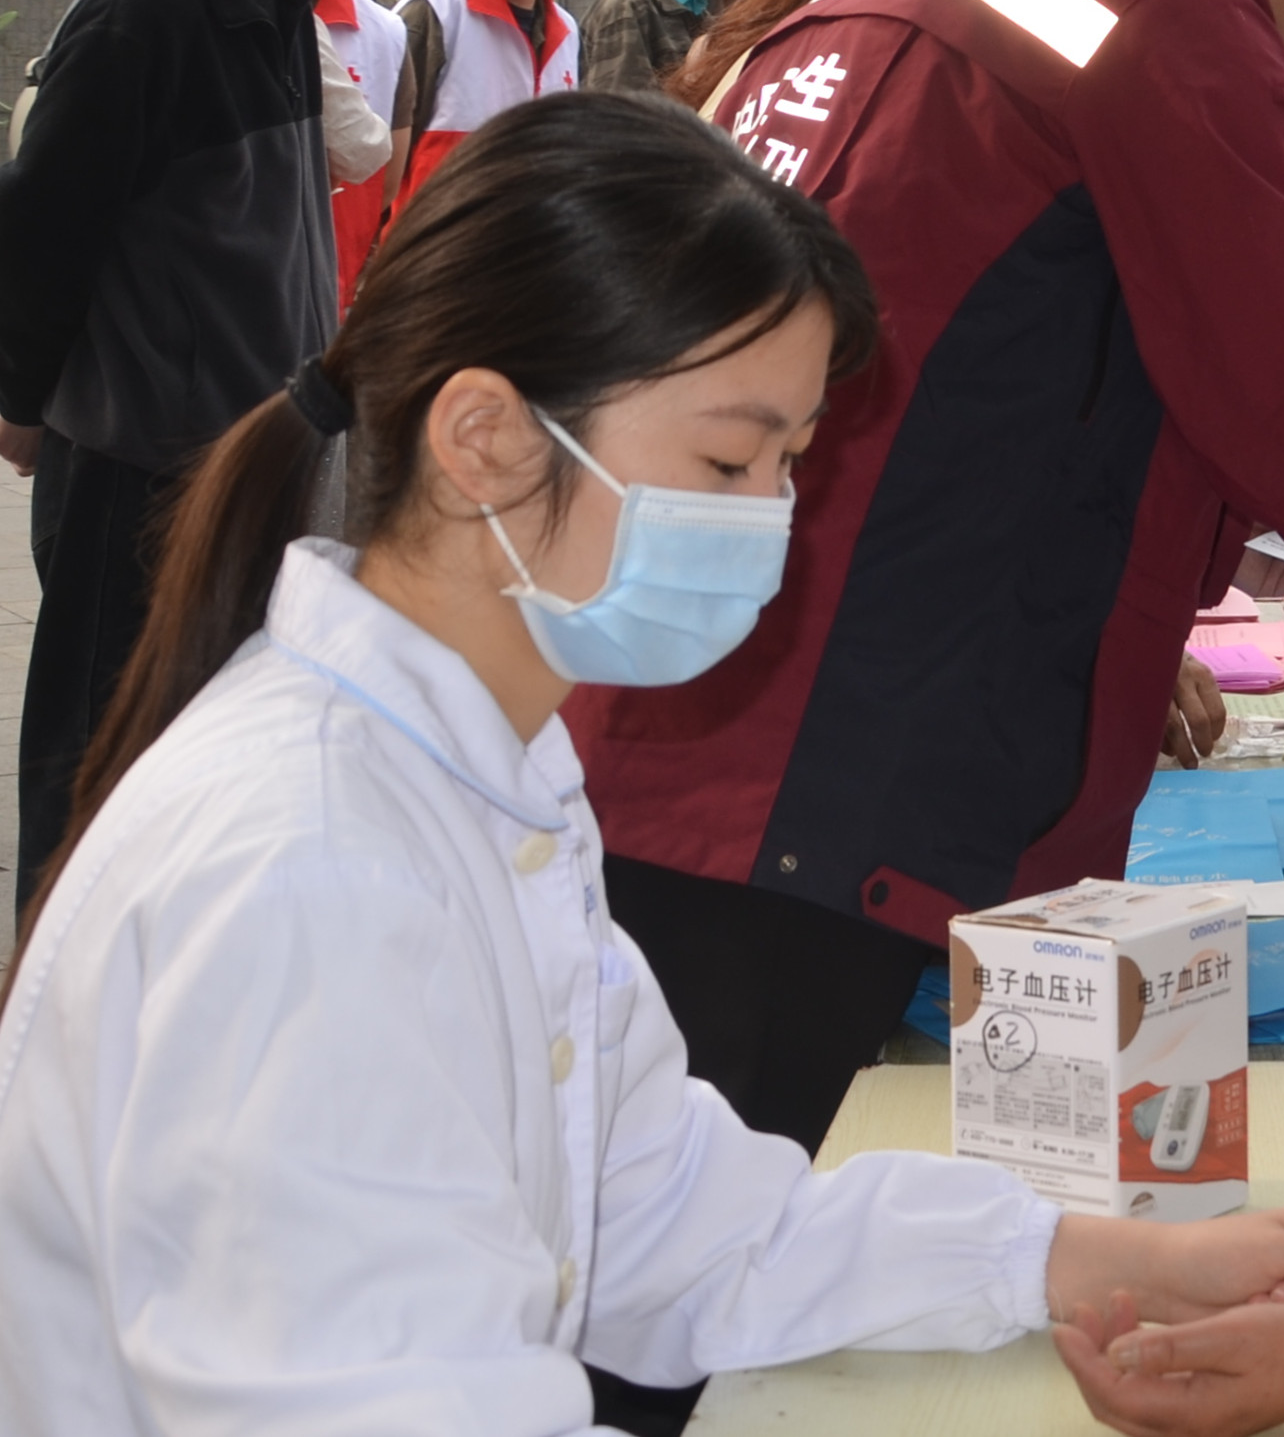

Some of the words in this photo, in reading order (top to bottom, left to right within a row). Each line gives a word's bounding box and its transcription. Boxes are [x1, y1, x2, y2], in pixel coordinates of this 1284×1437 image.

[973, 964, 1098, 1007] 电子血压计
[1138, 952, 1232, 1005] 电子血压计
